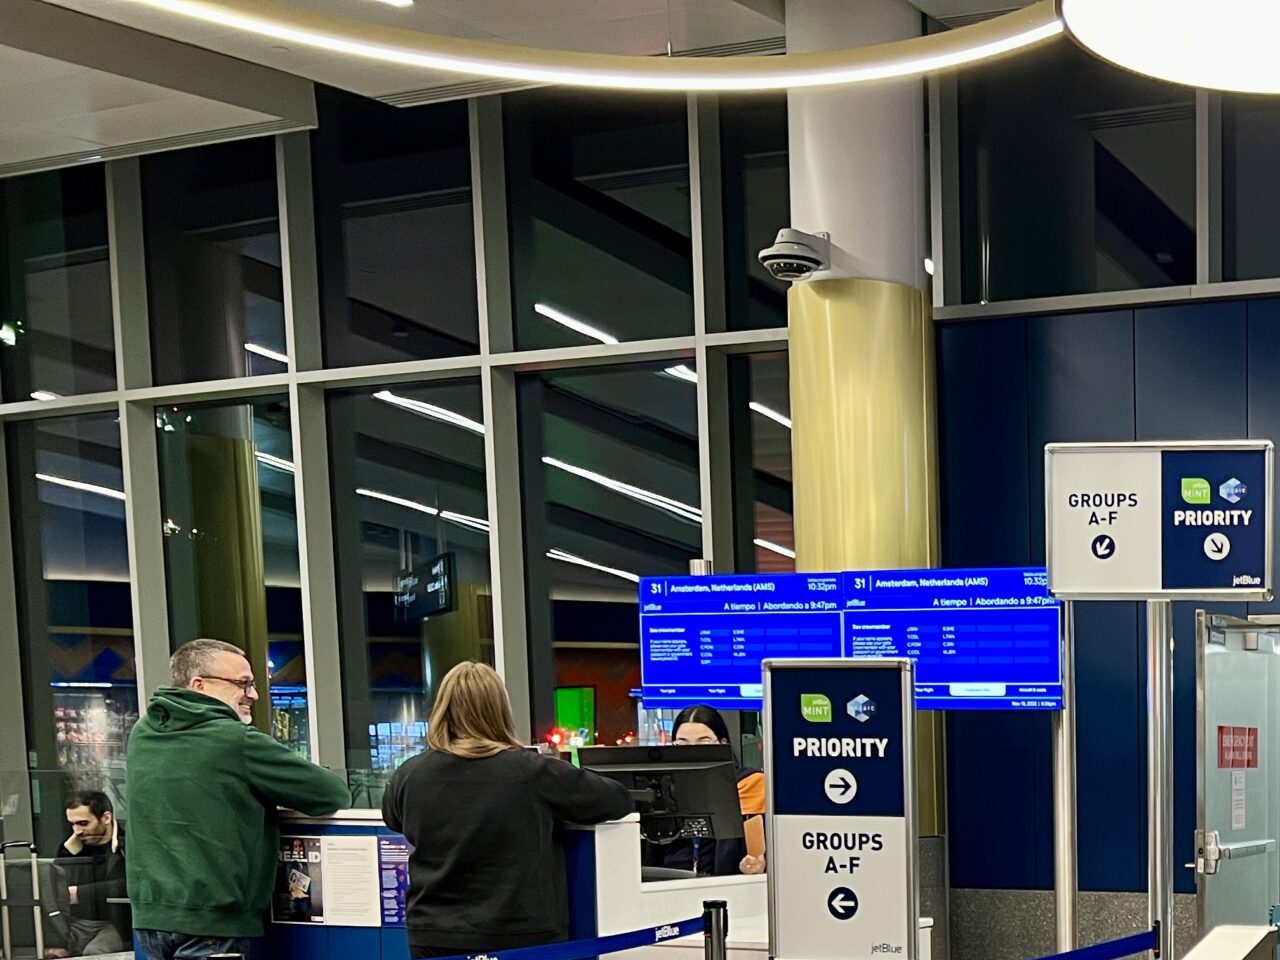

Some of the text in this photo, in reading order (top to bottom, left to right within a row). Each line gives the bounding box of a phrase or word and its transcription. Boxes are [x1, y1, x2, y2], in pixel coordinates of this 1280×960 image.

[1184, 489, 1208, 498] MINT
[1068, 493, 1138, 508] GROUPS
[1088, 511, 1118, 526] A-F
[1174, 510, 1253, 526] PRIORITY
[808, 582, 837, 592] 10:32pm
[854, 577, 989, 589] 31 Amsterdam, Netherlands (AMS)
[1024, 577, 1049, 587] 10:32p
[1232, 575, 1261, 587] jetBlue
[650, 582, 776, 594] 31 Amsterdam, Netherlands (AMS)
[723, 602, 756, 612] A tiempo
[763, 601, 804, 611] Abordando
[810, 601, 837, 611] 9:47pm
[933, 598, 967, 608] A tiempo
[975, 597, 1019, 606] Abordando
[1019, 598, 1025, 606] a
[803, 706, 830, 716] MINT
[793, 737, 889, 758] PRIORITY
[802, 832, 883, 851] GROUPS
[824, 856, 860, 874] A-F
[655, 923, 680, 941] jetBlue
[871, 943, 903, 955] jetBlue
